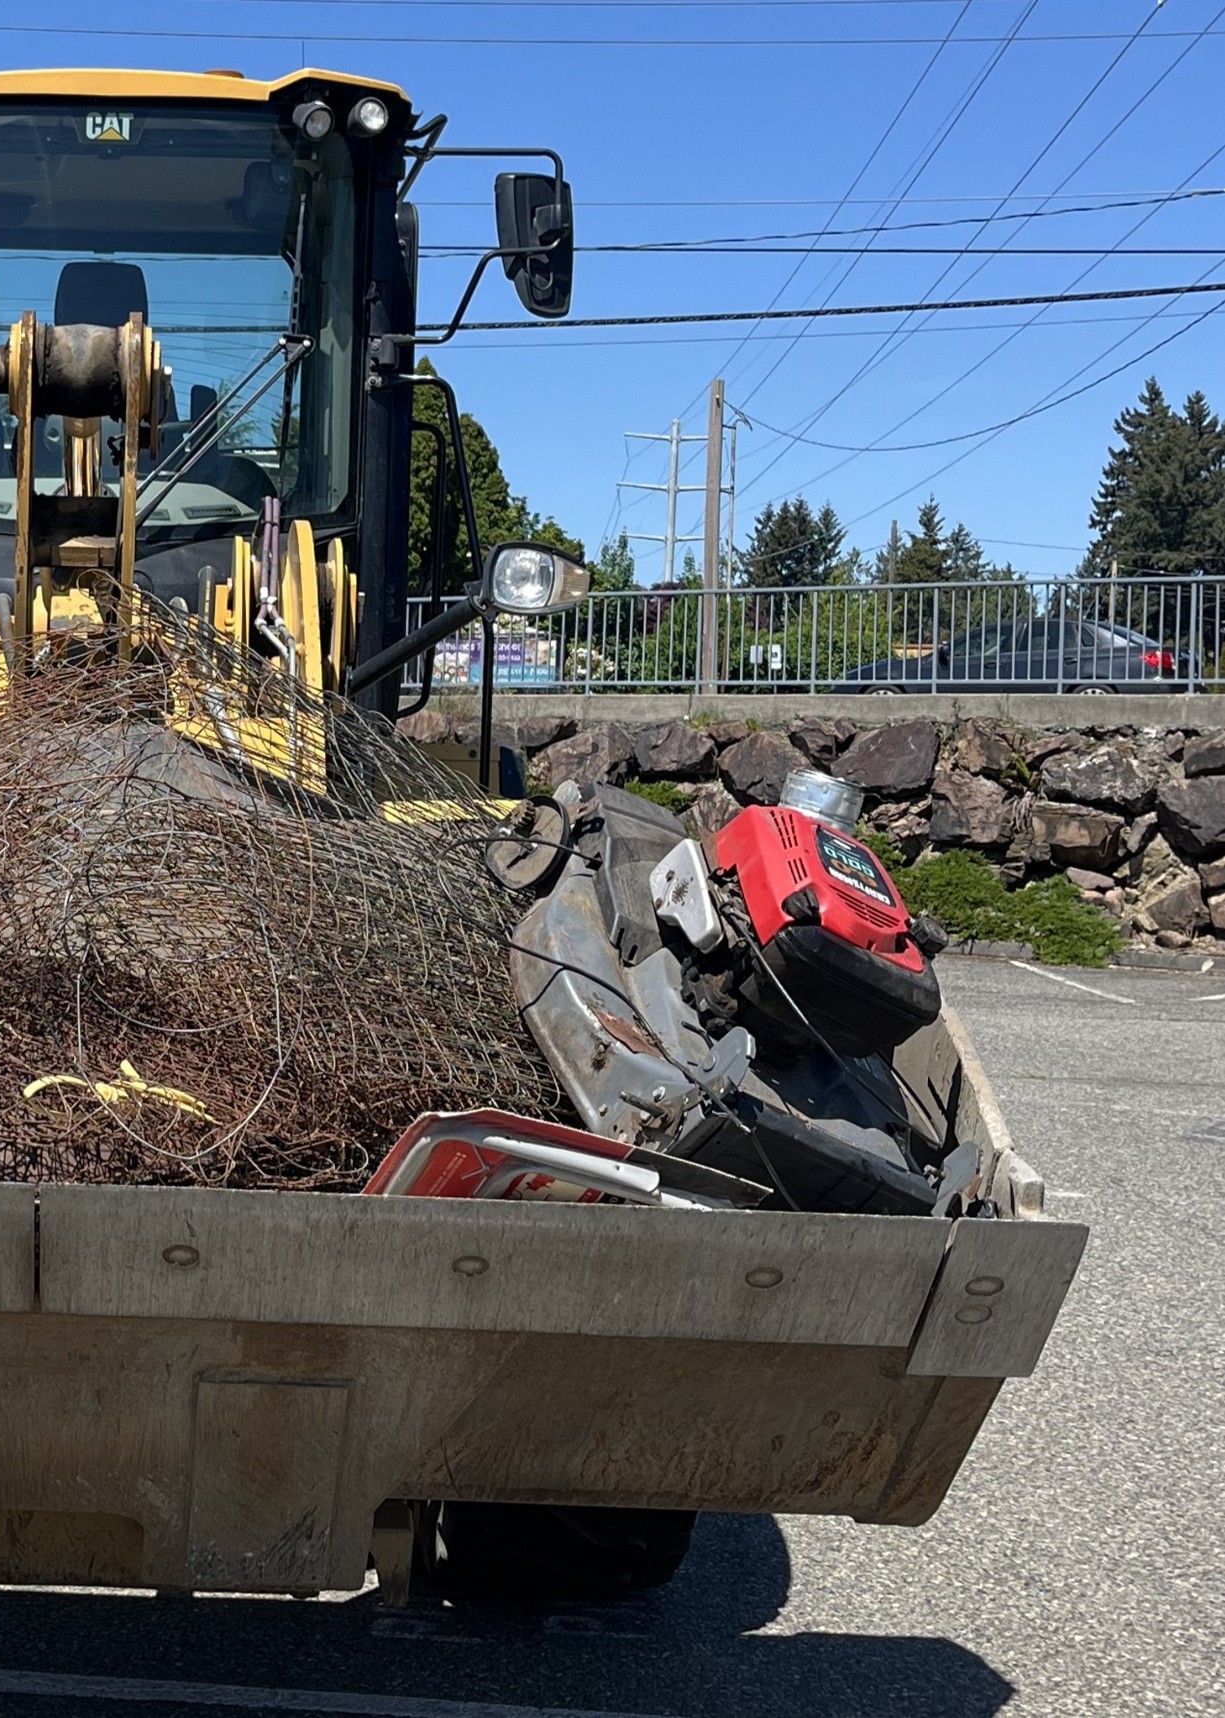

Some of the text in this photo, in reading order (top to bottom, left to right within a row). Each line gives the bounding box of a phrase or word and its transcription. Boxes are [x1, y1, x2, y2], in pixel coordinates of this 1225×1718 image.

[86, 112, 134, 140] CAT
[823, 845, 875, 878] GOLD
[829, 866, 891, 905] CRAFTSMAN
